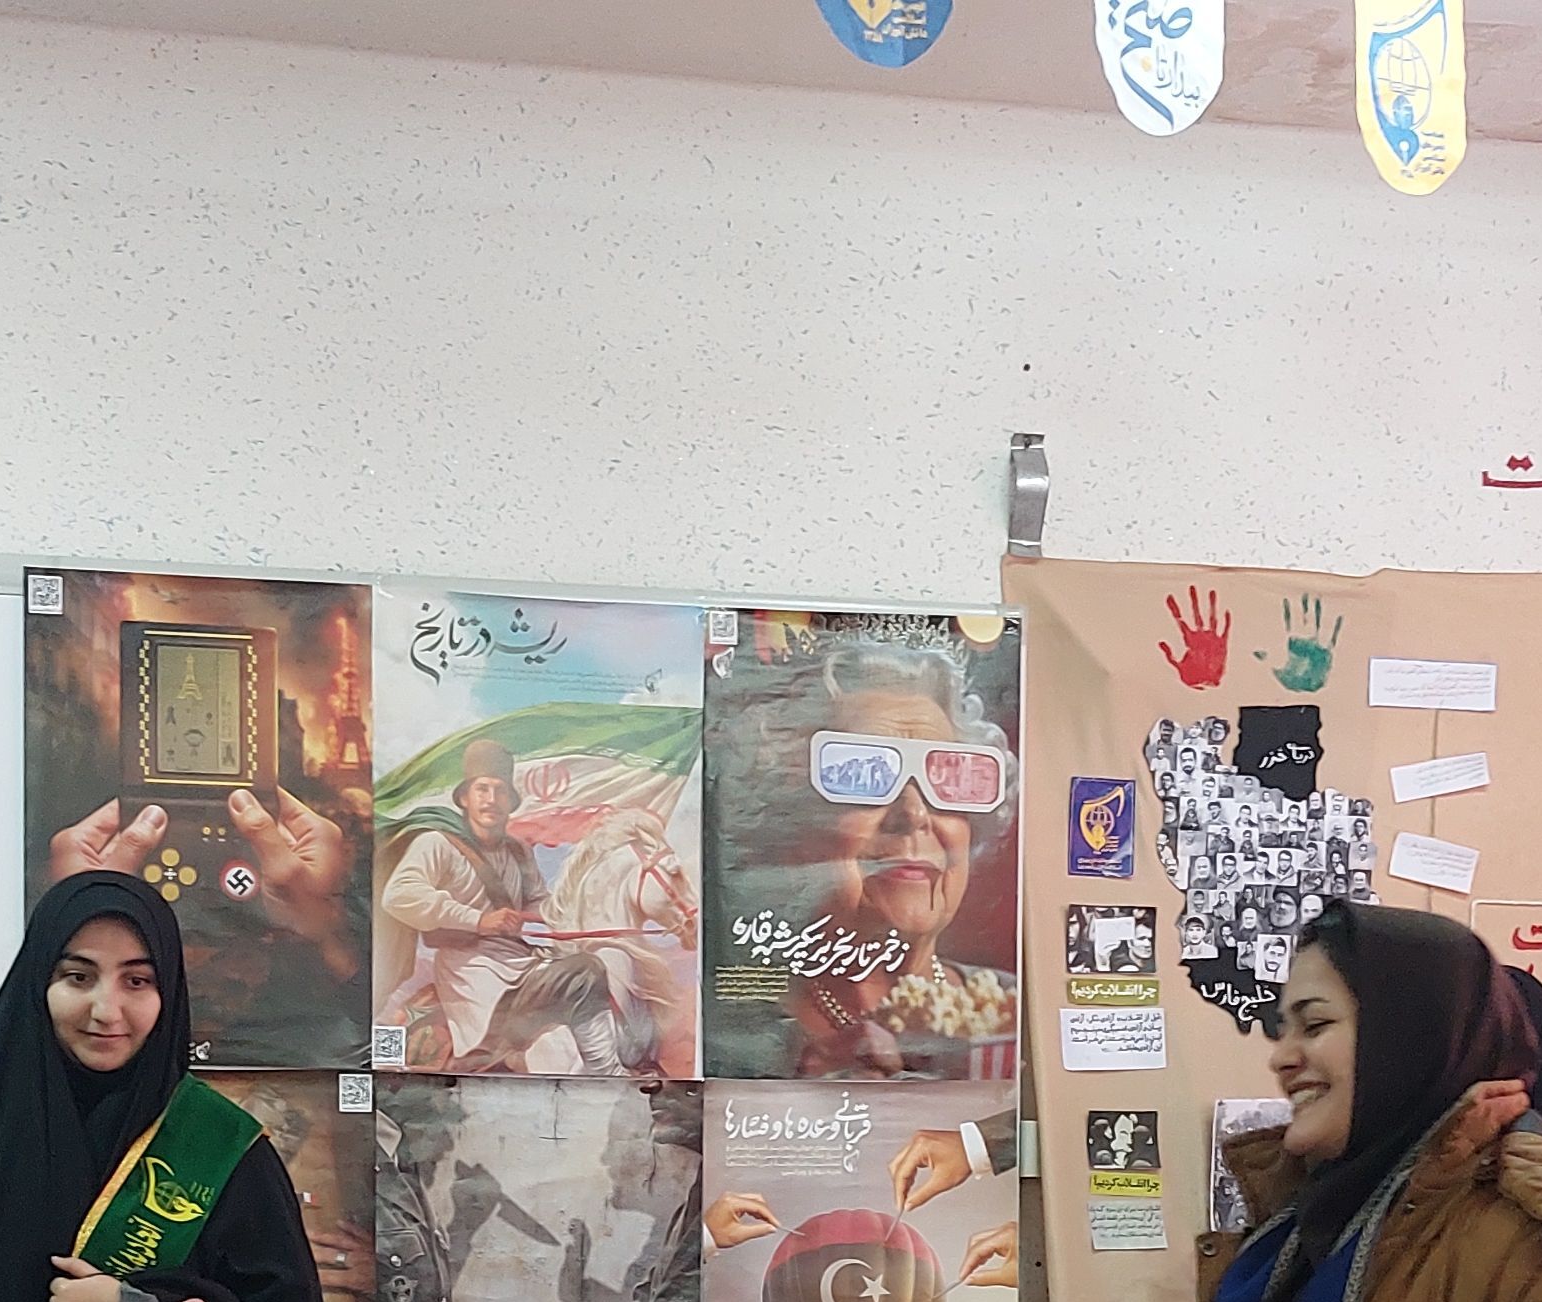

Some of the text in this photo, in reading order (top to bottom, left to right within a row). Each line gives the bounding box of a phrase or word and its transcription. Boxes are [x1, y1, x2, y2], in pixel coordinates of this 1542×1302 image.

[409, 602, 482, 687] تاریخ
[1258, 747, 1289, 769] خزر
[732, 910, 774, 945] قاره
[1201, 982, 1243, 1008] فارس
